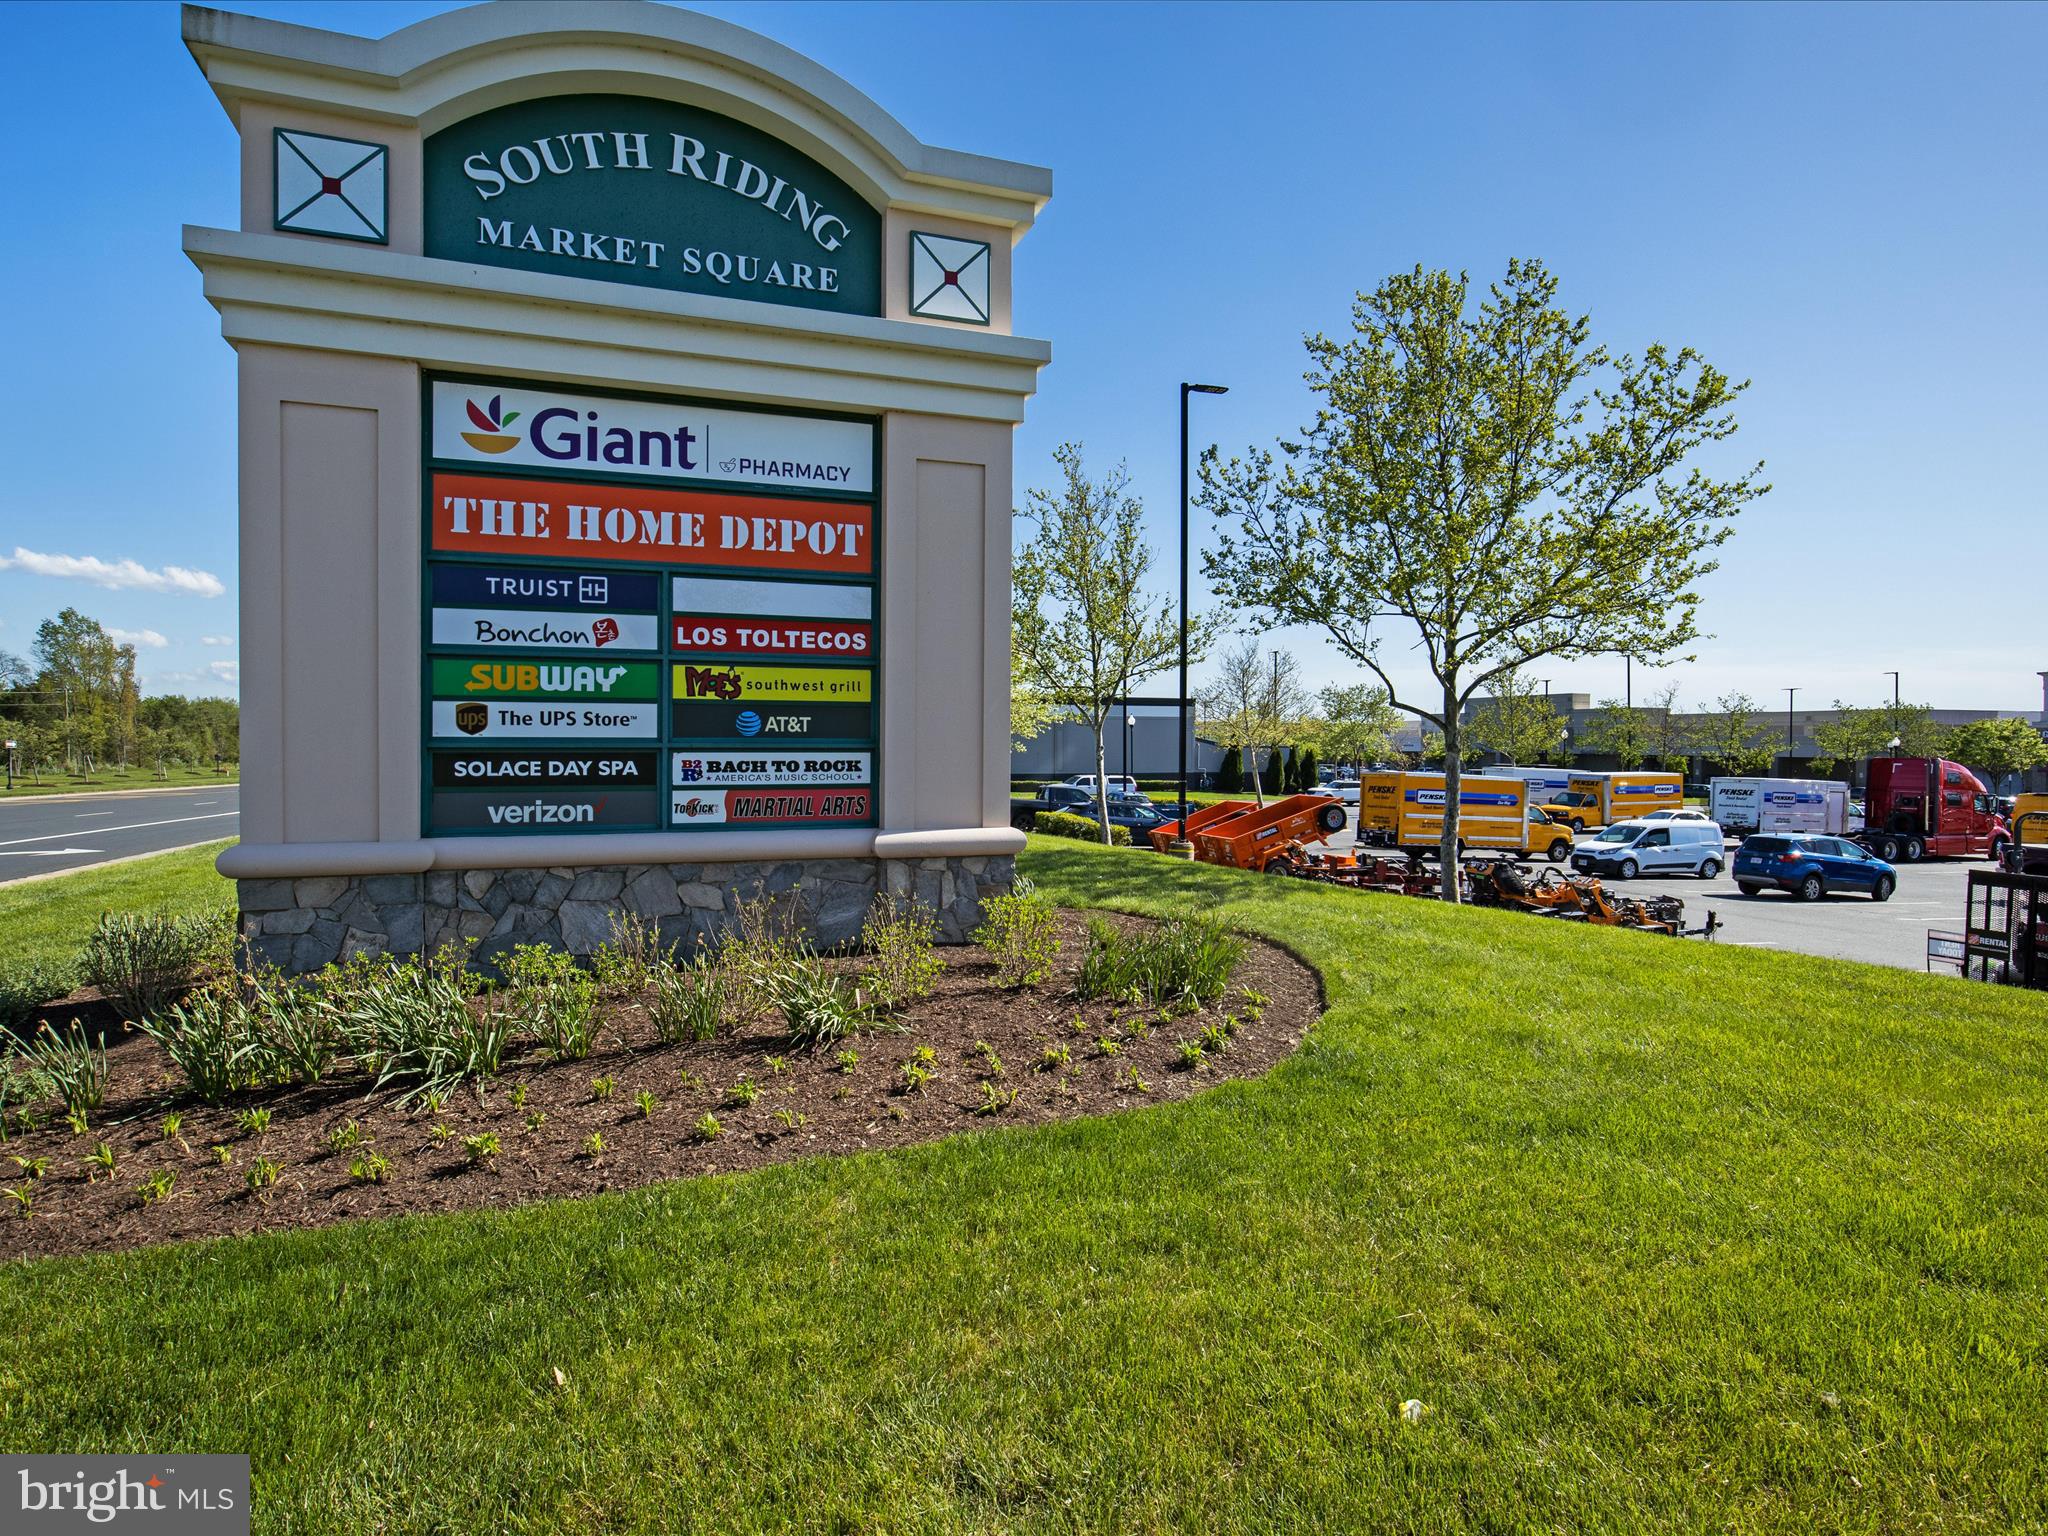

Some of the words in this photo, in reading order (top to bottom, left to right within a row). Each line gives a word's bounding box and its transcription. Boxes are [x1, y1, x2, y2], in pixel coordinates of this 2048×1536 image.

[463, 131, 653, 200] SOUTH
[666, 133, 852, 252] RIDING
[477, 216, 665, 269] MARKET
[683, 247, 840, 293] SQUARE
[530, 407, 697, 470] Giant
[739, 458, 851, 483] PHARMACY
[444, 496, 550, 538] THE
[566, 505, 705, 548] HOME
[720, 515, 865, 556] DEPOT
[486, 577, 573, 597] TRUIST
[474, 619, 590, 644] Bonchon
[677, 626, 727, 646] LOS
[736, 628, 867, 650] TOLTECOS
[464, 664, 628, 693] SUBWAY
[746, 679, 824, 692] southwest
[830, 680, 862, 694] grill
[458, 711, 486, 730] ups
[498, 710, 533, 726] The
[540, 711, 576, 726] UPS
[765, 716, 811, 733] AT&T
[454, 760, 541, 777] SOLACE
[548, 760, 592, 776] DAY
[598, 760, 639, 776] SPA
[706, 760, 768, 773] BACH
[771, 760, 800, 773] TO
[804, 760, 862, 773] ROCK
[714, 774, 771, 782] AMERICA'S
[774, 773, 808, 782] MUSIC
[811, 773, 855, 781] SCHOOL
[1368, 785, 1397, 794] PENSKE
[1719, 788, 1756, 796] PENSKE
[487, 800, 594, 824] verizon
[732, 797, 814, 818] MARTIAL
[820, 796, 866, 816] ARTS
[1979, 937, 2008, 948] RENTAL
